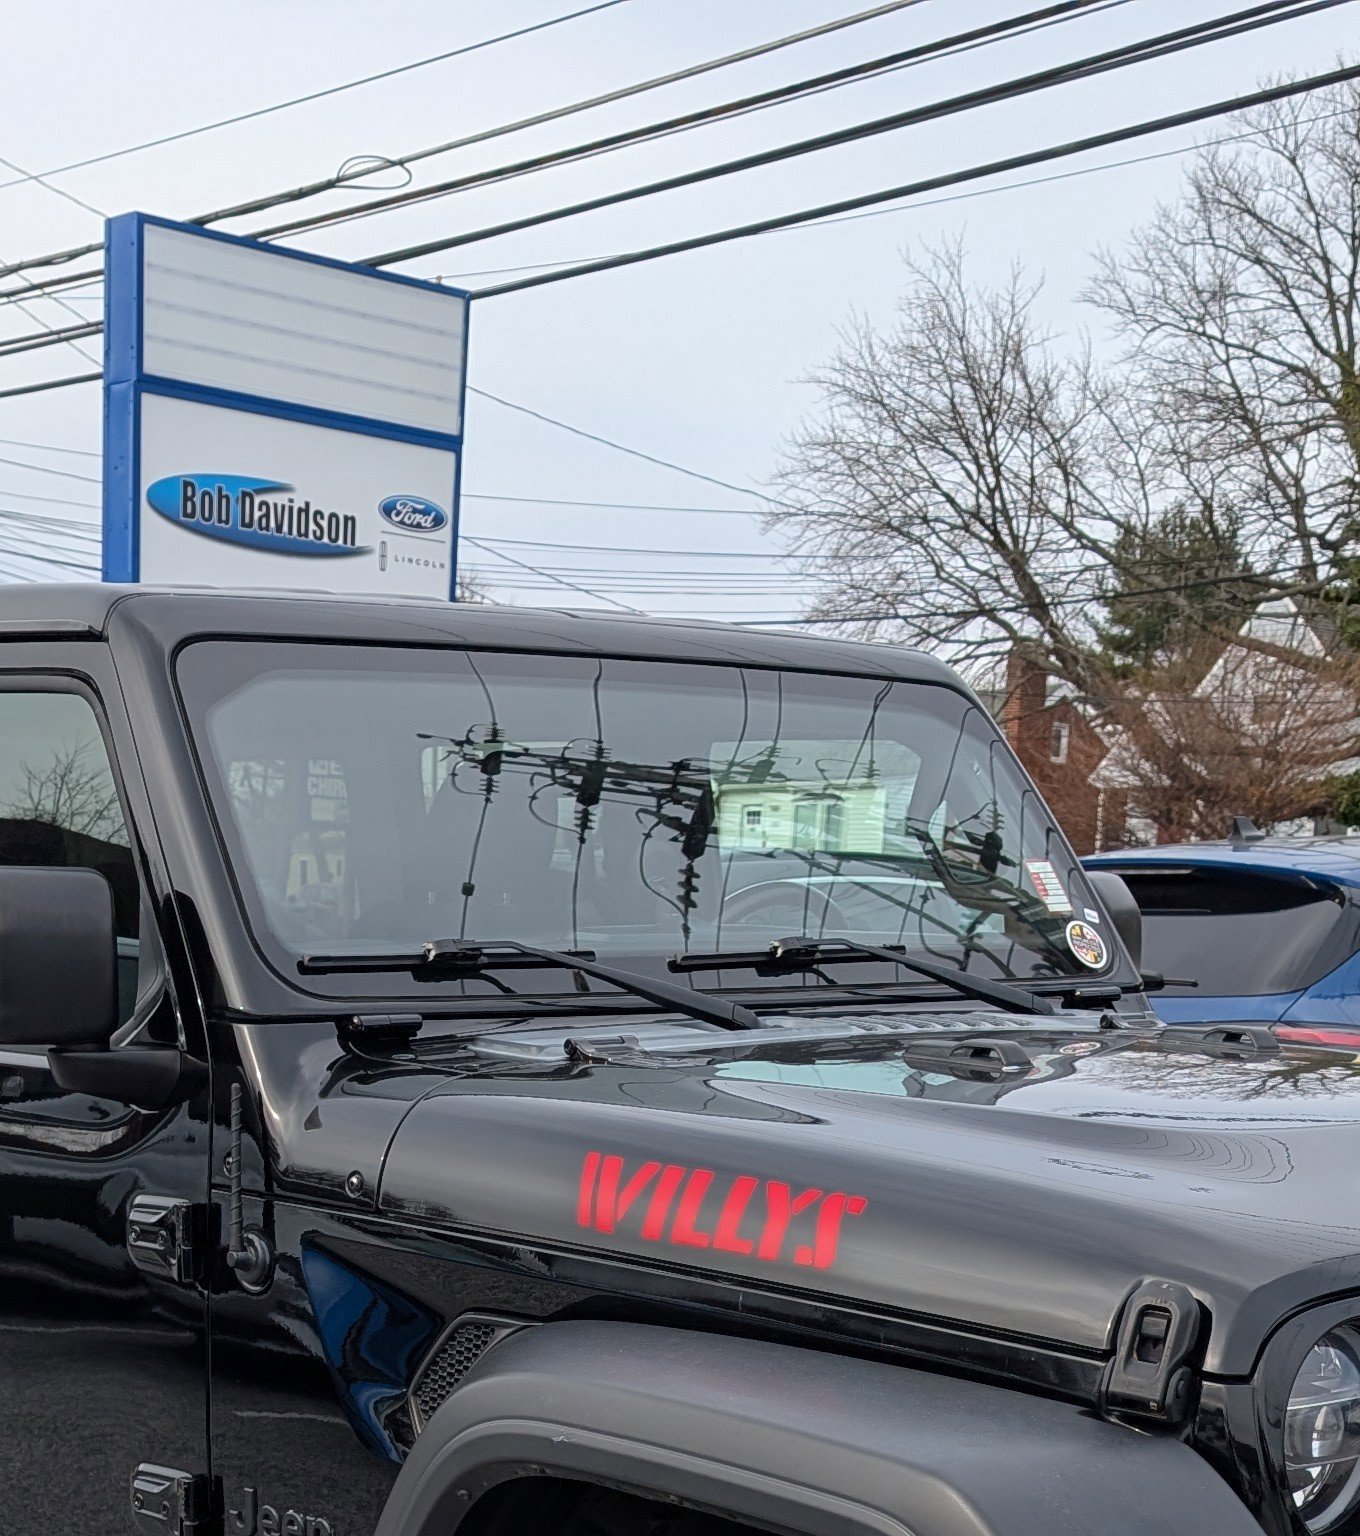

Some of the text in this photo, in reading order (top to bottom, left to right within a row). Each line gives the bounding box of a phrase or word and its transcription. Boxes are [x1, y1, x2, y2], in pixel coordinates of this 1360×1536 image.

[179, 478, 358, 548] Bob Davidson
[388, 499, 438, 530] Ford
[393, 554, 446, 570] LINCOLN
[577, 1151, 868, 1270] WILLYS
